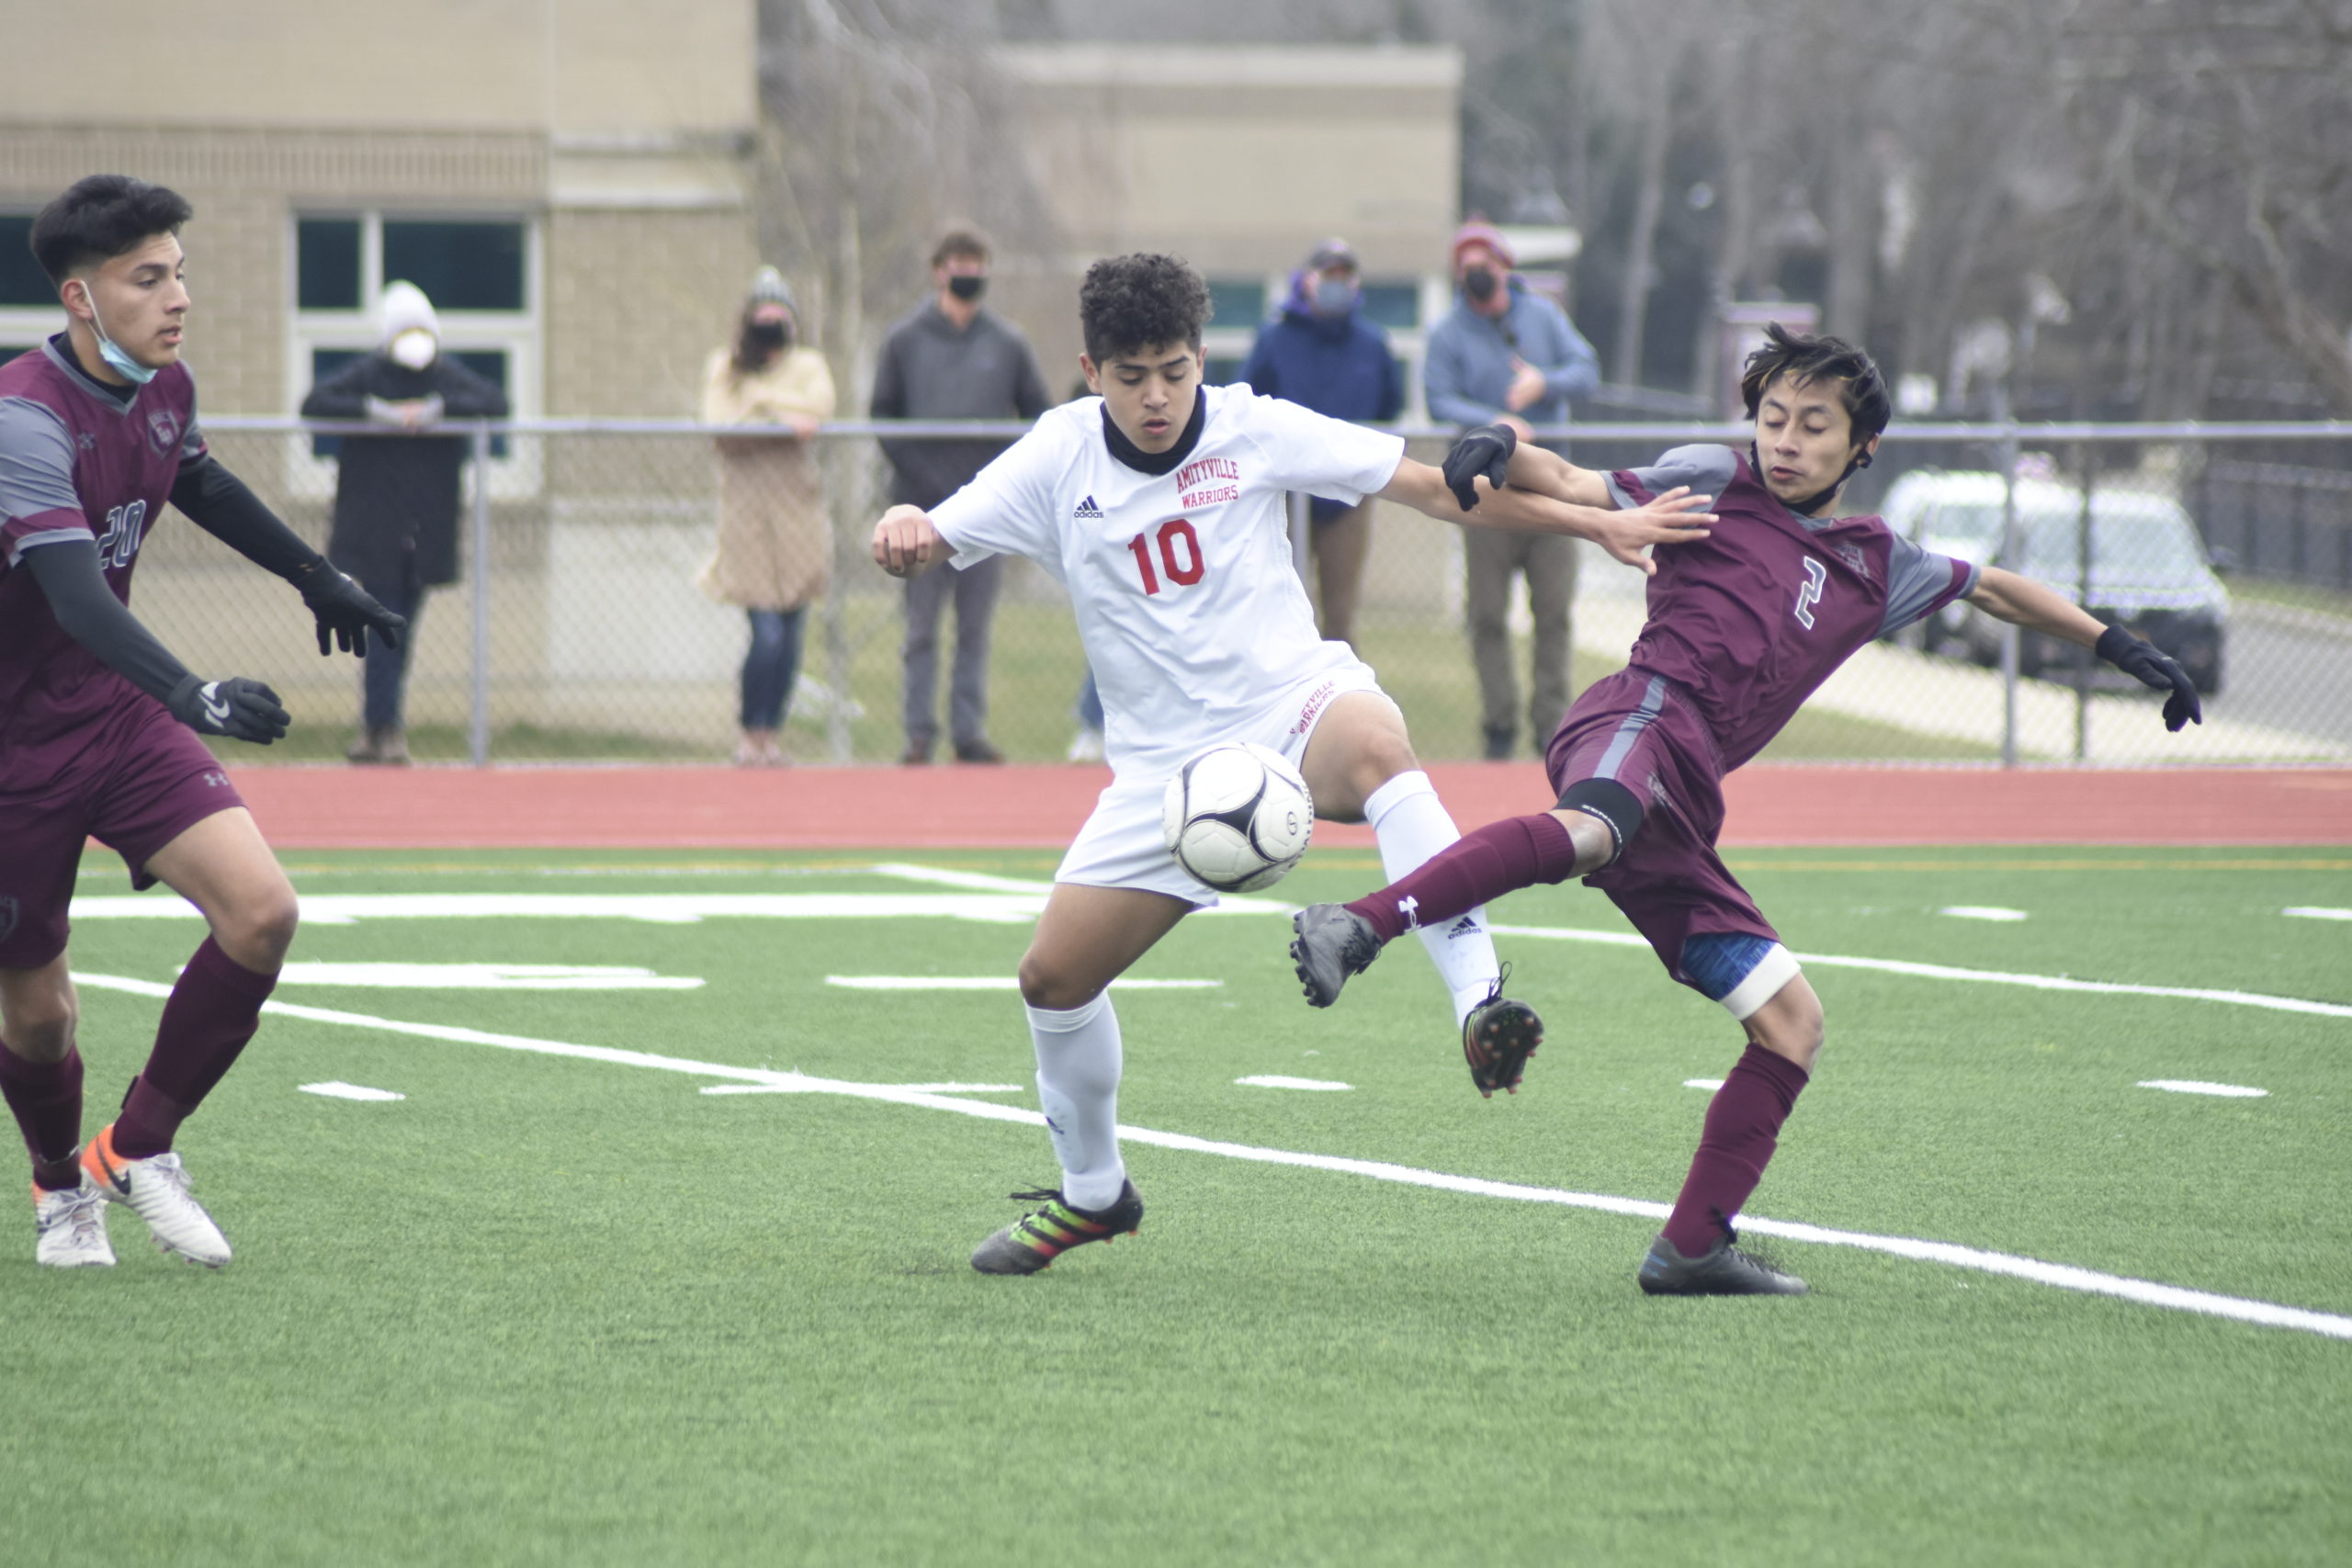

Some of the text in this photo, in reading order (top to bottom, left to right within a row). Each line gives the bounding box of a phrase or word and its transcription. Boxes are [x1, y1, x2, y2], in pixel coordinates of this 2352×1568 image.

[1176, 457, 1239, 494] AMITYVILLE
[1074, 509, 1104, 519] adidas
[1182, 484, 1238, 510] WARRIORS
[96, 499, 147, 570] 20
[1127, 518, 1205, 595] 10
[1794, 555, 1826, 631] 2
[1448, 926, 1483, 940] adidas
